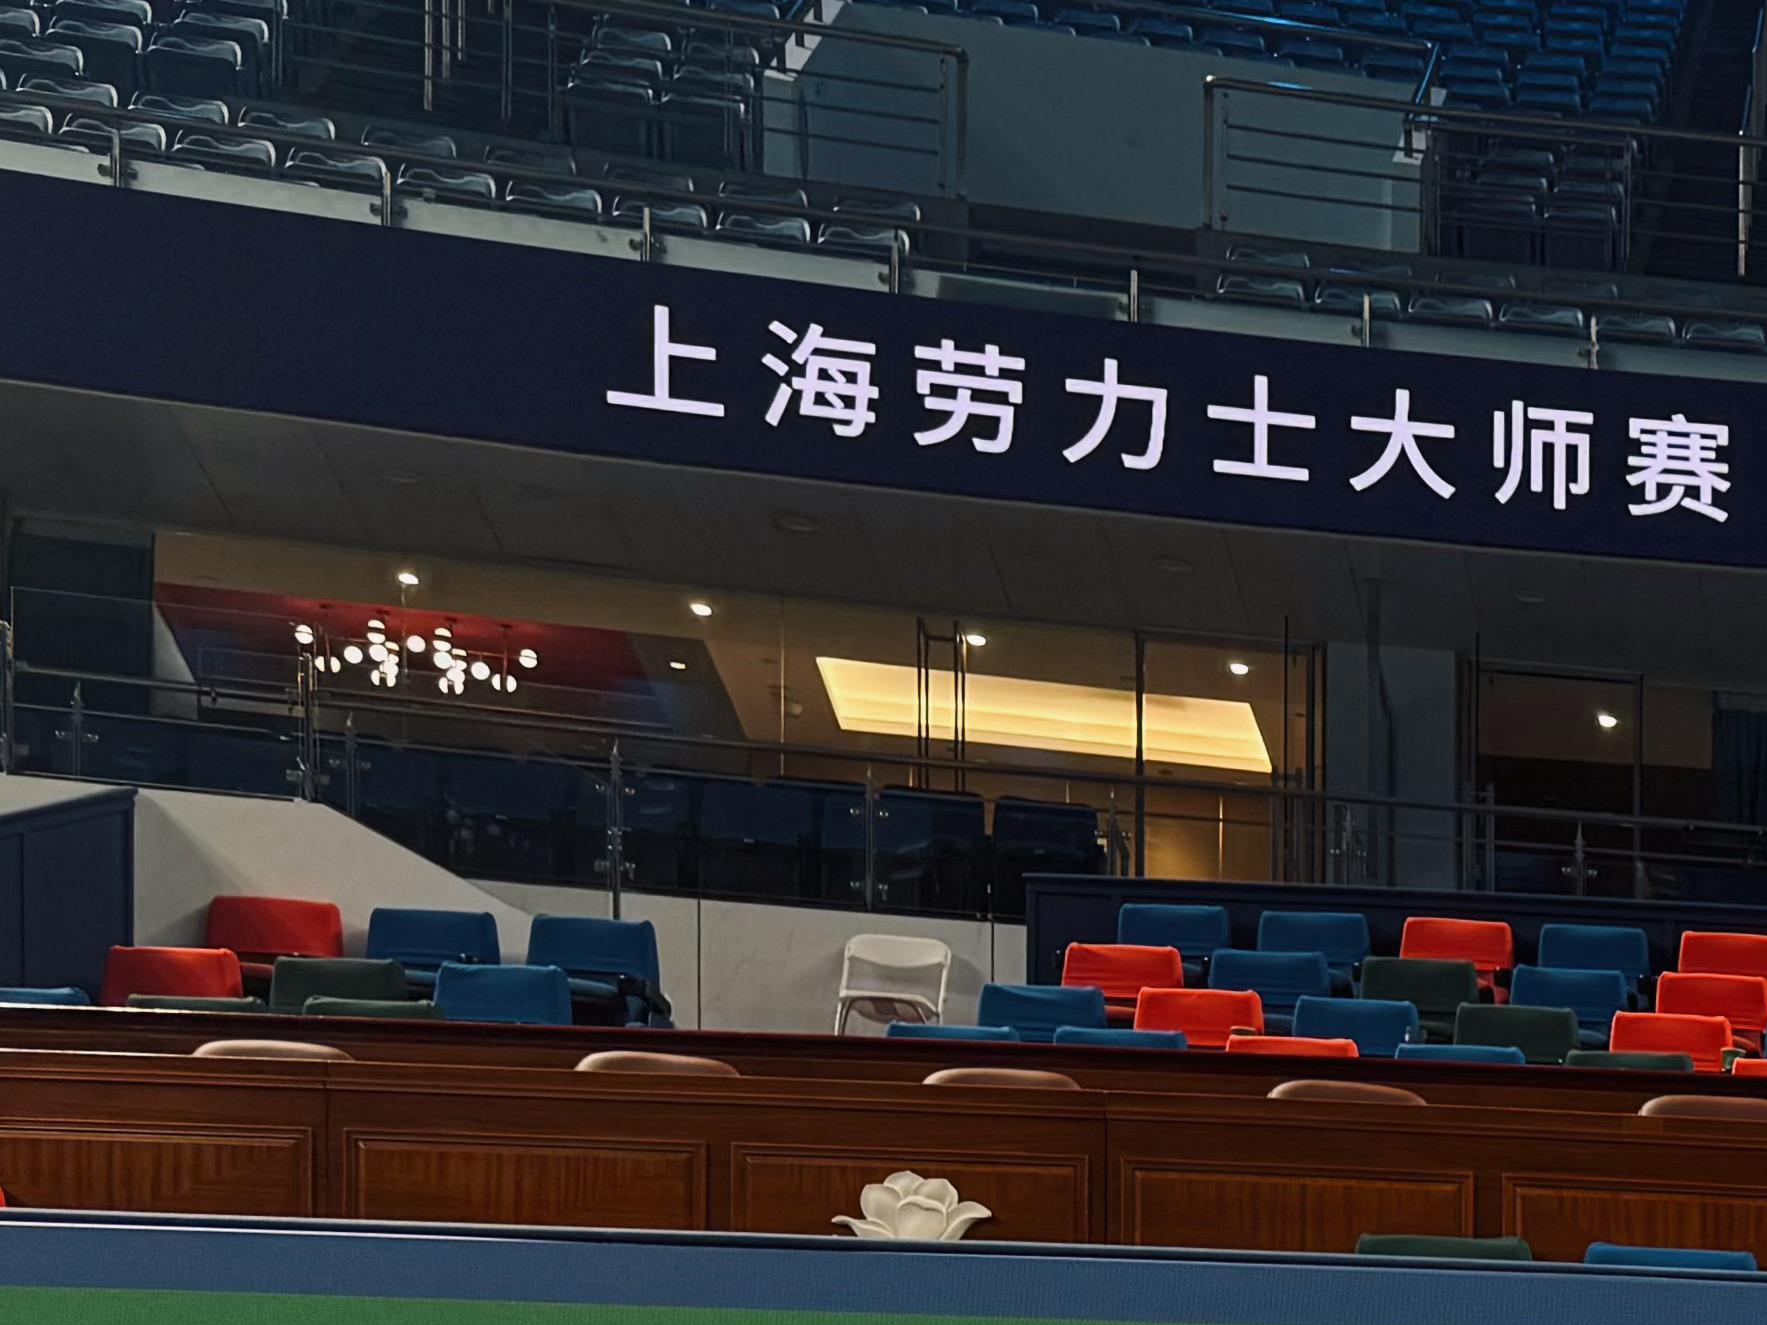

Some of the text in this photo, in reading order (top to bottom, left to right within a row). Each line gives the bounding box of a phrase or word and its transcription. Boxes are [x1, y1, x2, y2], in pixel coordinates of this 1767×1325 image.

[606, 296, 1731, 523] 上海劳力士大师赛
